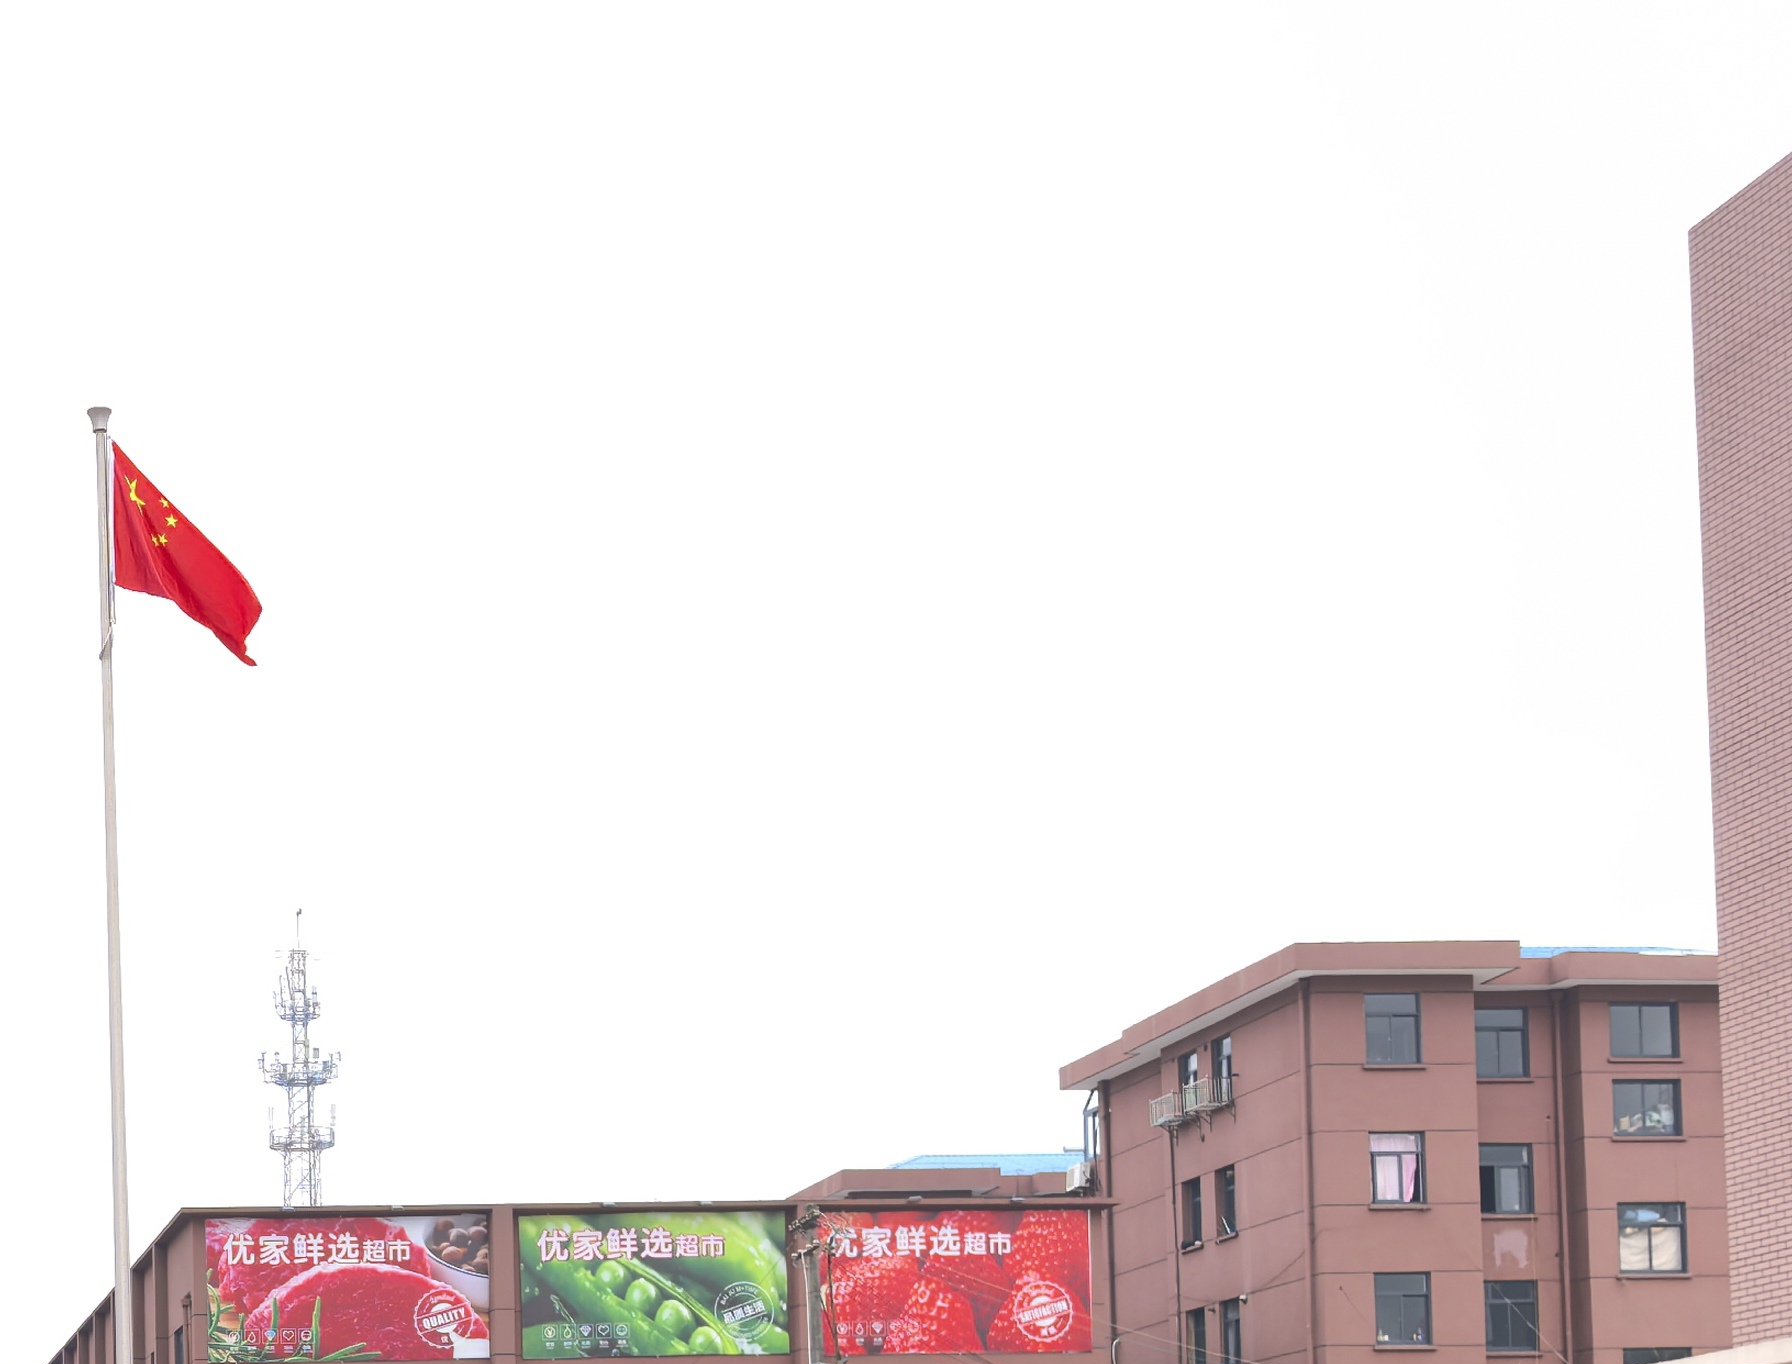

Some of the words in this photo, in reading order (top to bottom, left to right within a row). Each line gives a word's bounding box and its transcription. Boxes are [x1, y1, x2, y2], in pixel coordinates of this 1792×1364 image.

[224, 1231, 411, 1265] 优家鲜选超市
[537, 1226, 725, 1262] 优家鲜选超市
[422, 1307, 466, 1330] QUALITY
